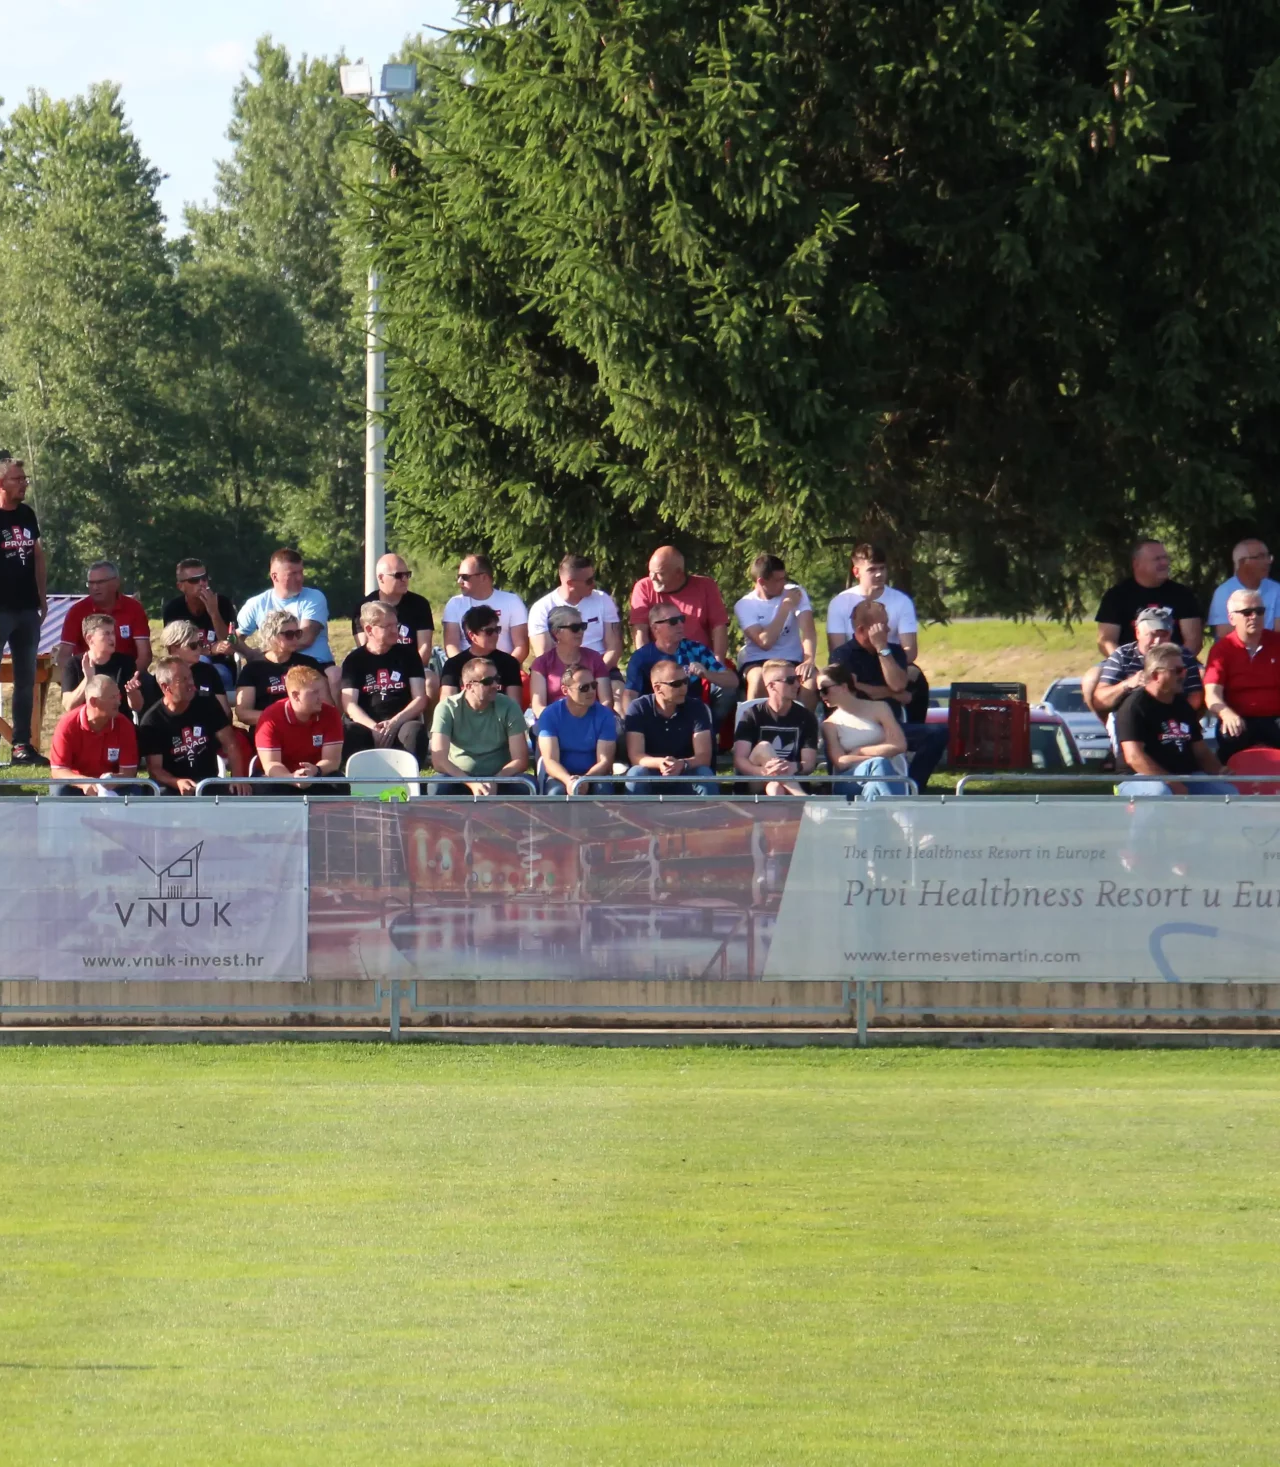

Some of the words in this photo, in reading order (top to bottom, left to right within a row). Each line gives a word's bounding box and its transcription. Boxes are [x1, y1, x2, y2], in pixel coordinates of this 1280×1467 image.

[843, 845, 867, 860] The
[871, 845, 901, 861] first
[987, 845, 1032, 860] Resort
[1036, 846, 1051, 860] in
[1056, 846, 1107, 862] Europe
[844, 879, 908, 907] Prvi
[1095, 880, 1193, 908] Resort
[1202, 887, 1221, 908] u
[114, 902, 233, 928] VNUK
[81, 953, 265, 968] www.vnuk-invest.hr
[843, 949, 1081, 964] www.termesvetimartin.com
